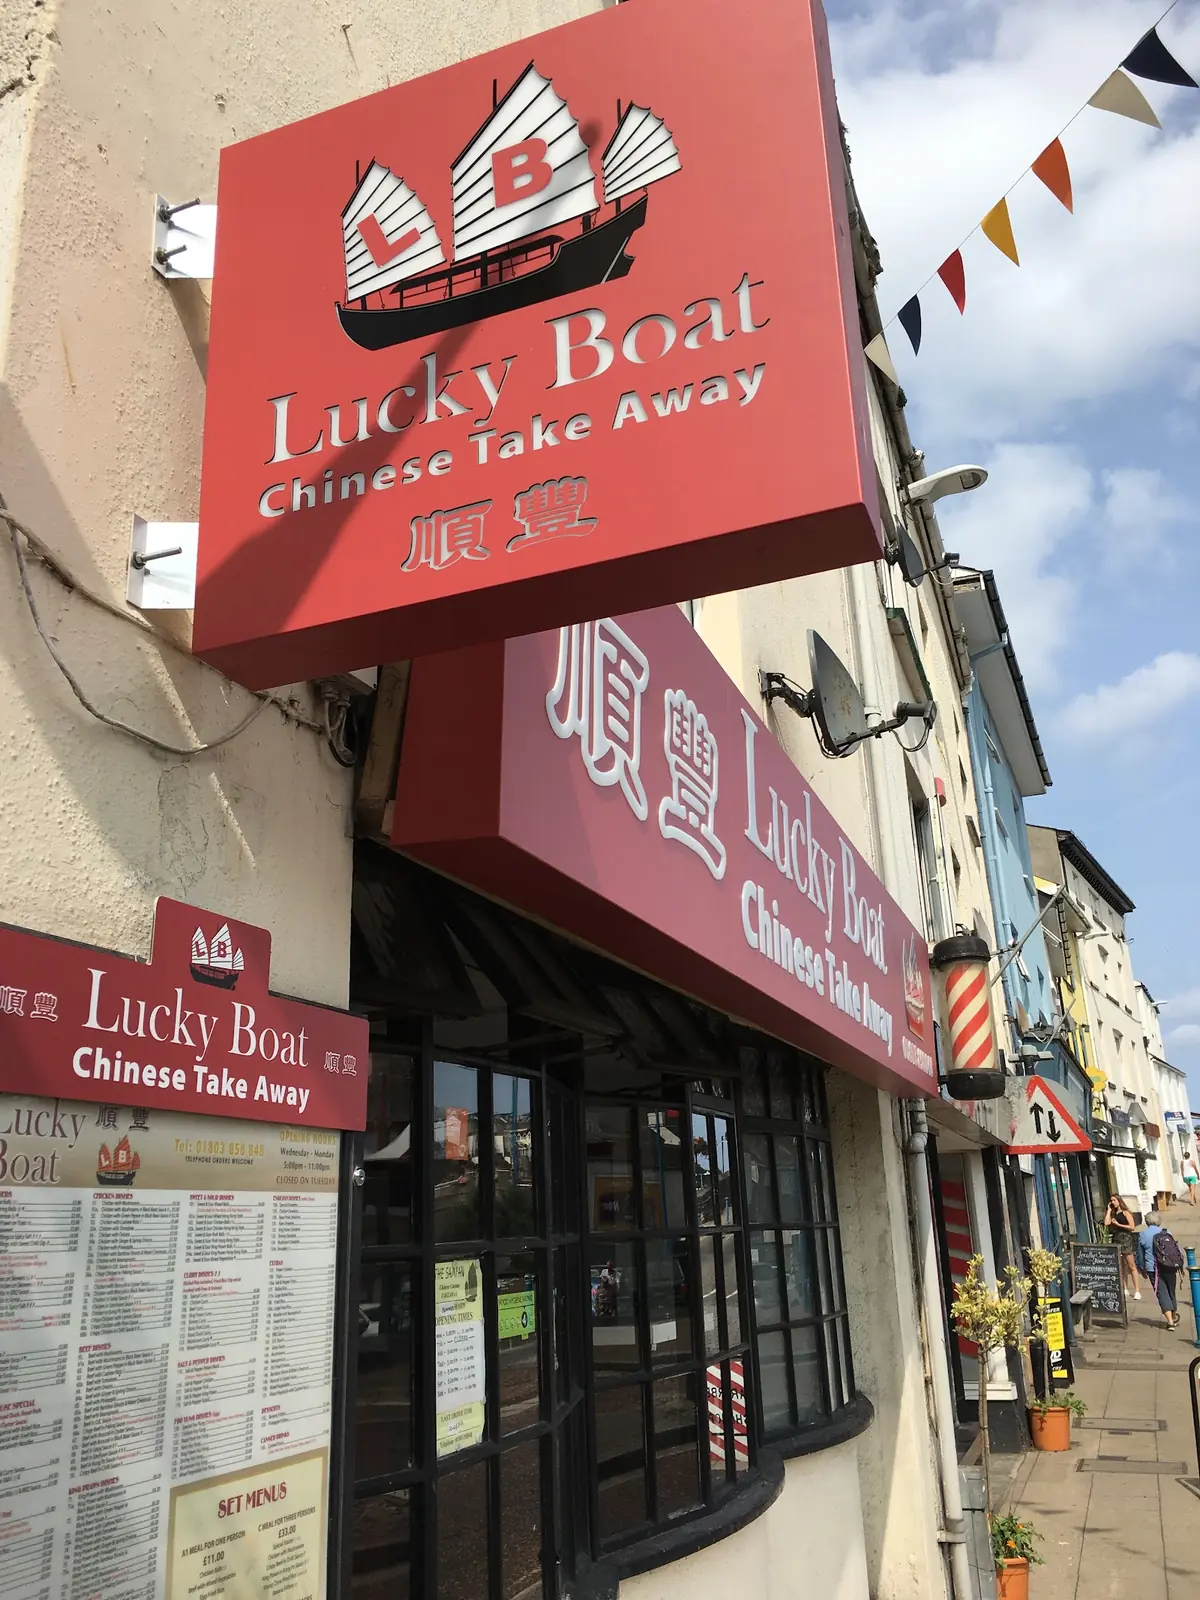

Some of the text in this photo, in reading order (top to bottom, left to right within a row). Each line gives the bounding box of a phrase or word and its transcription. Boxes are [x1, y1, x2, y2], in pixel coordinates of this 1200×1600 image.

[491, 137, 554, 210] B
[263, 272, 770, 467] Lucky Boat
[258, 361, 767, 518] Chinese Take Away
[741, 708, 888, 975] Lucky Boat
[741, 880, 825, 996] Chinese
[825, 948, 861, 1023] Take
[863, 981, 893, 1057] Away
[81, 967, 310, 1068] Lucky Boat
[72, 1046, 310, 1114] Chinese Take Away
[174, 1138, 193, 1154] Tel:
[195, 1140, 225, 1155] 01803
[280, 1147, 310, 1159] Wednesday
[314, 1150, 334, 1160] Monday
[276, 1175, 299, 1184] CLOSED
[300, 1176, 309, 1185] ON
[218, 1482, 287, 1518] SET MENUS
[261, 1521, 274, 1531] MEAL
[275, 1516, 283, 1526] FOR
[284, 1513, 296, 1523] THREE
[297, 1506, 316, 1519] PERSONS
[189, 1544, 203, 1555] MEAL
[204, 1540, 215, 1549] FOR
[215, 1537, 226, 1546] ONE
[226, 1530, 246, 1543] PERSON
[203, 1551, 225, 1566] £11.00
